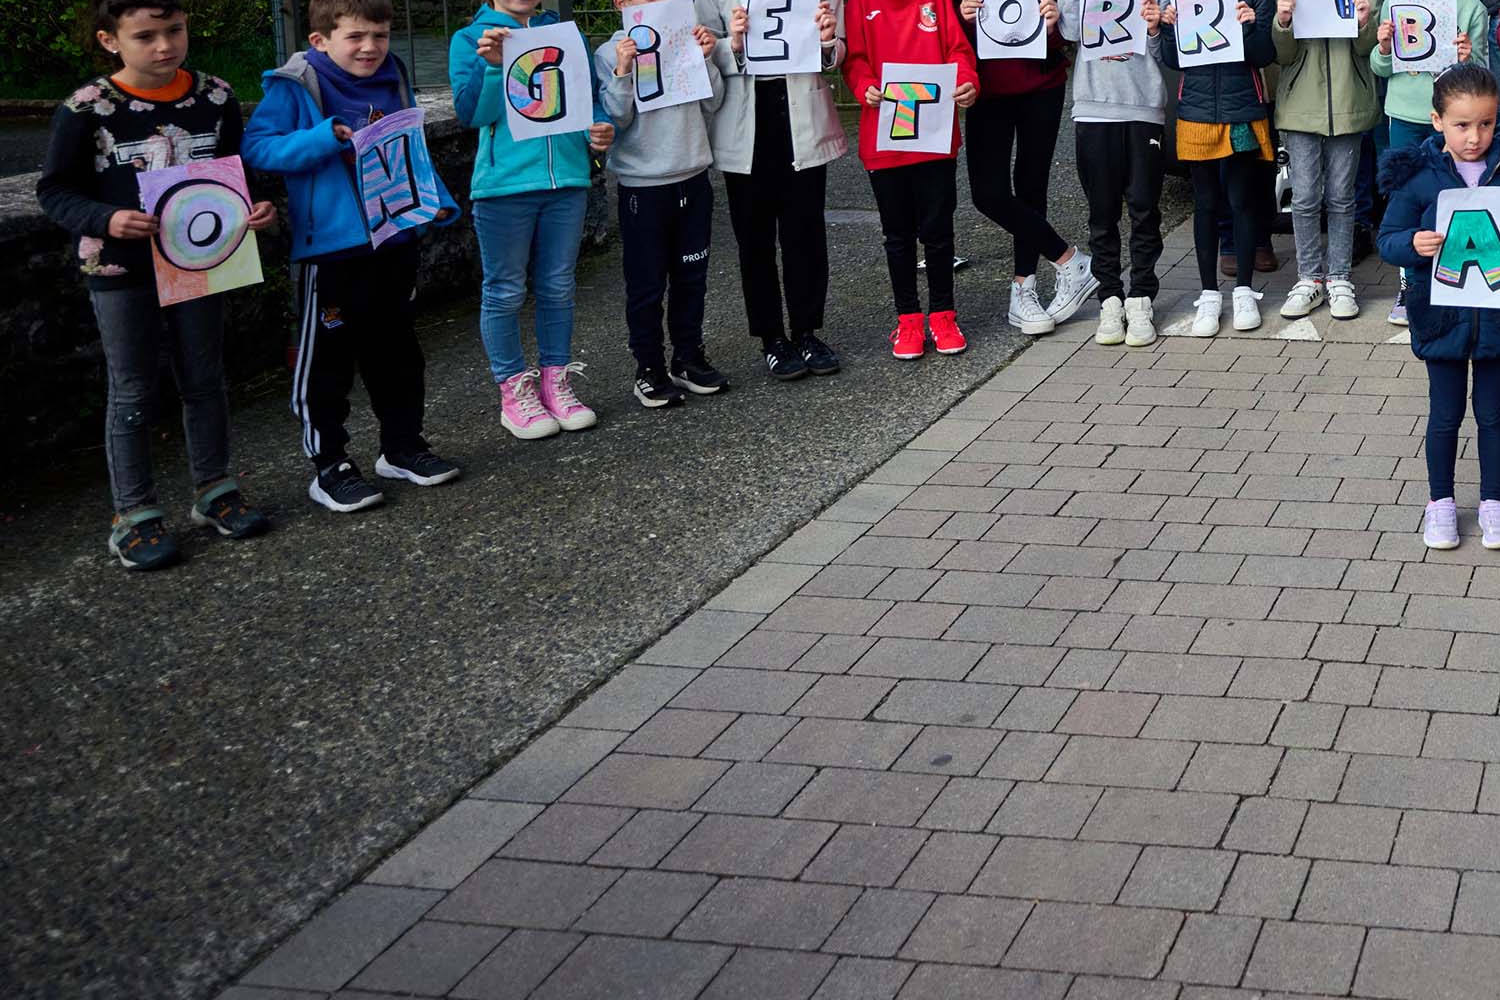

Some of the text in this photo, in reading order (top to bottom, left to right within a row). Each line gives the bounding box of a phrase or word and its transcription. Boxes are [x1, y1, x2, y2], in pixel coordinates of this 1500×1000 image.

[628, 24, 664, 102] i
[1391, 4, 1436, 61] B
[507, 47, 563, 122] G
[884, 82, 940, 140] T
[360, 133, 420, 233] N
[154, 179, 252, 271] O
